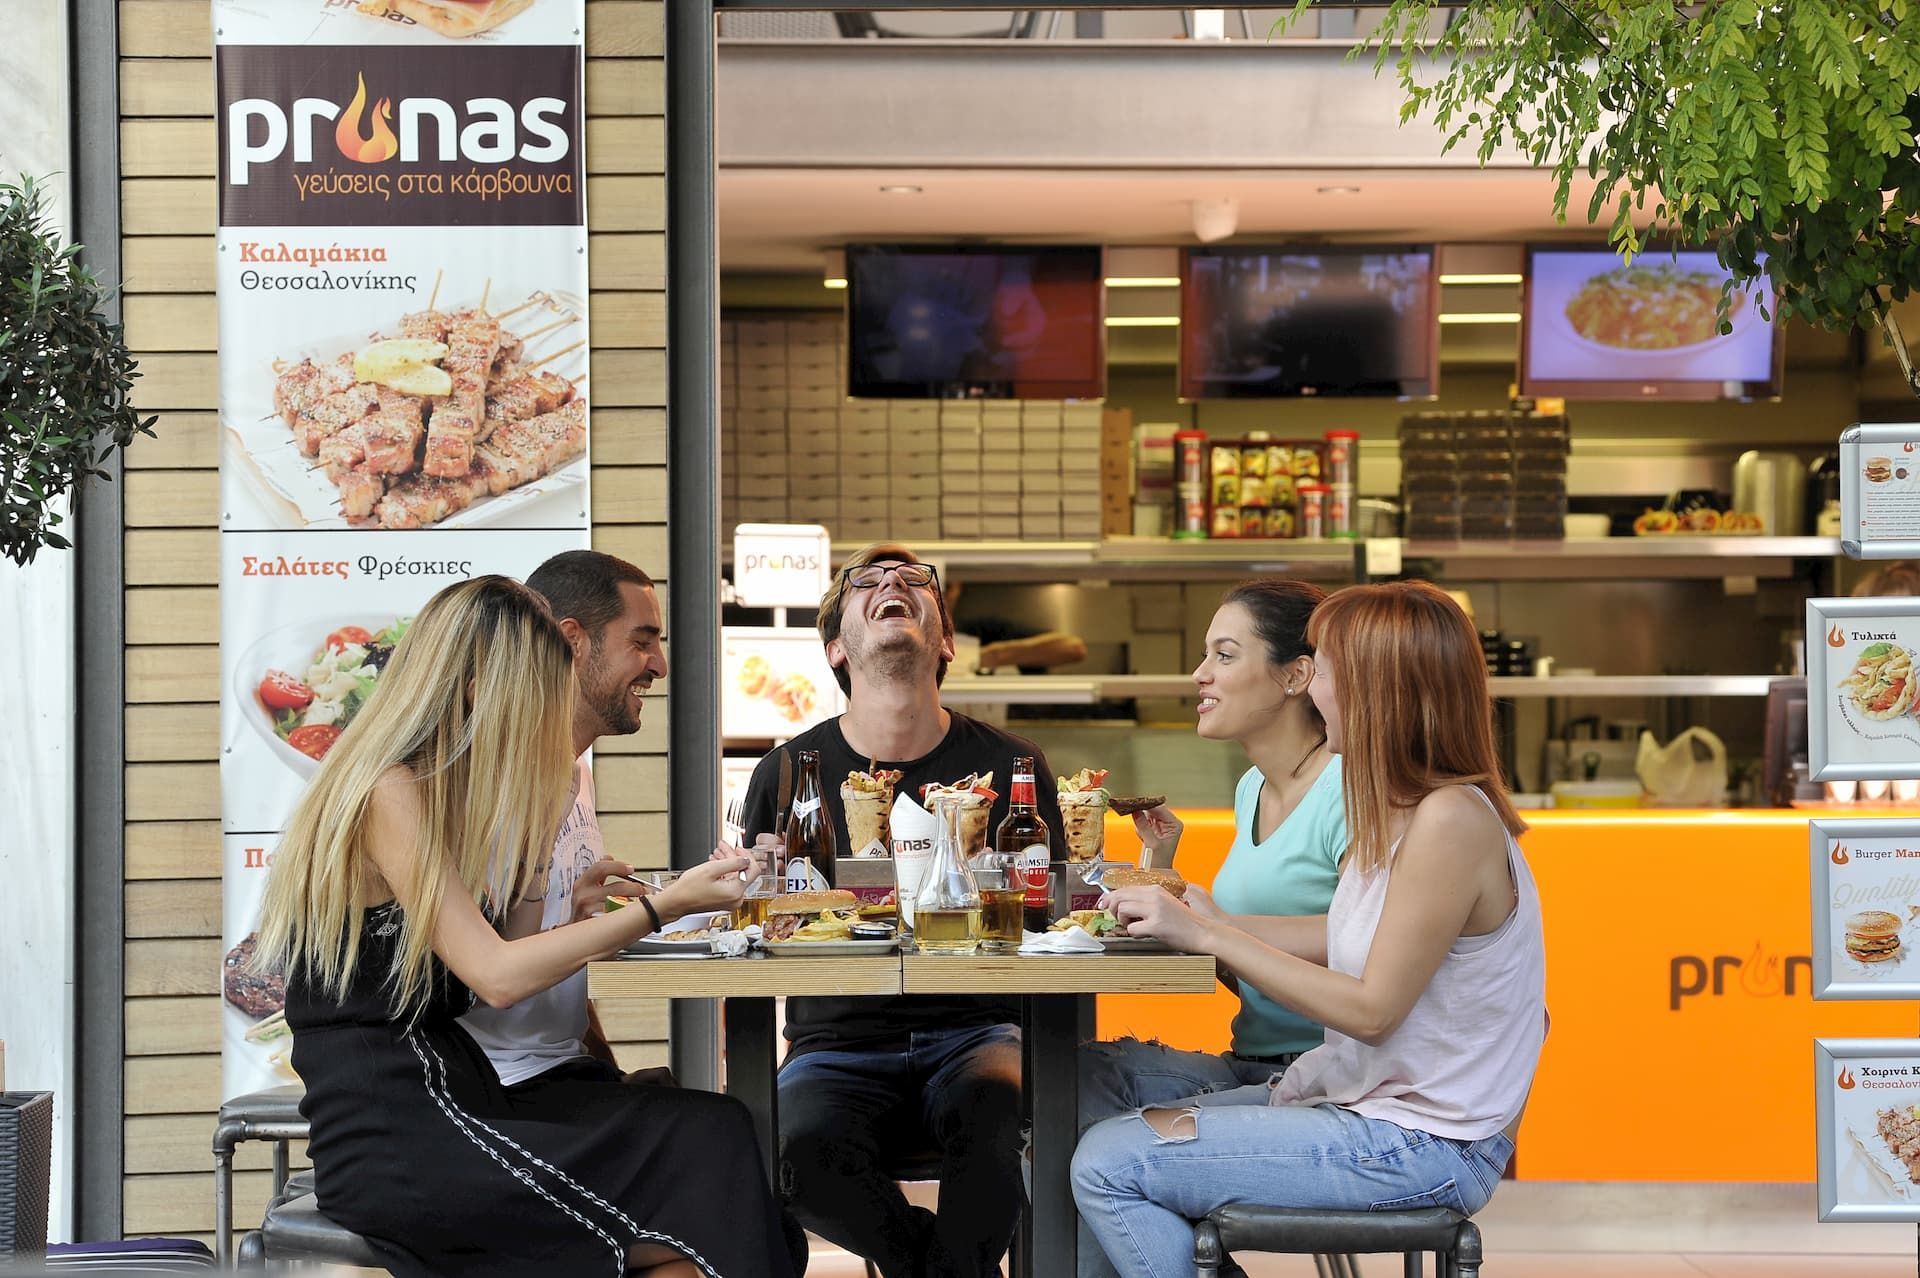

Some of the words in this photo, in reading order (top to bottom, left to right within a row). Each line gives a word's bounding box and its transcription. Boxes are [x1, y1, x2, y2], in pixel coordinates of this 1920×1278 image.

[294, 168, 390, 201] γεύσεις
[398, 175, 443, 194] στα
[451, 168, 573, 201] κάρβουνα
[239, 242, 387, 268] Καλαμάκια
[240, 270, 417, 294] Θεσσαλονίκης
[242, 555, 349, 579] Σαλάτες
[358, 555, 472, 580] Φρέσκιες
[1855, 849, 1892, 860] Burger
[787, 879, 816, 891] FIX
[1861, 1066, 1908, 1078] Χοιρινά
